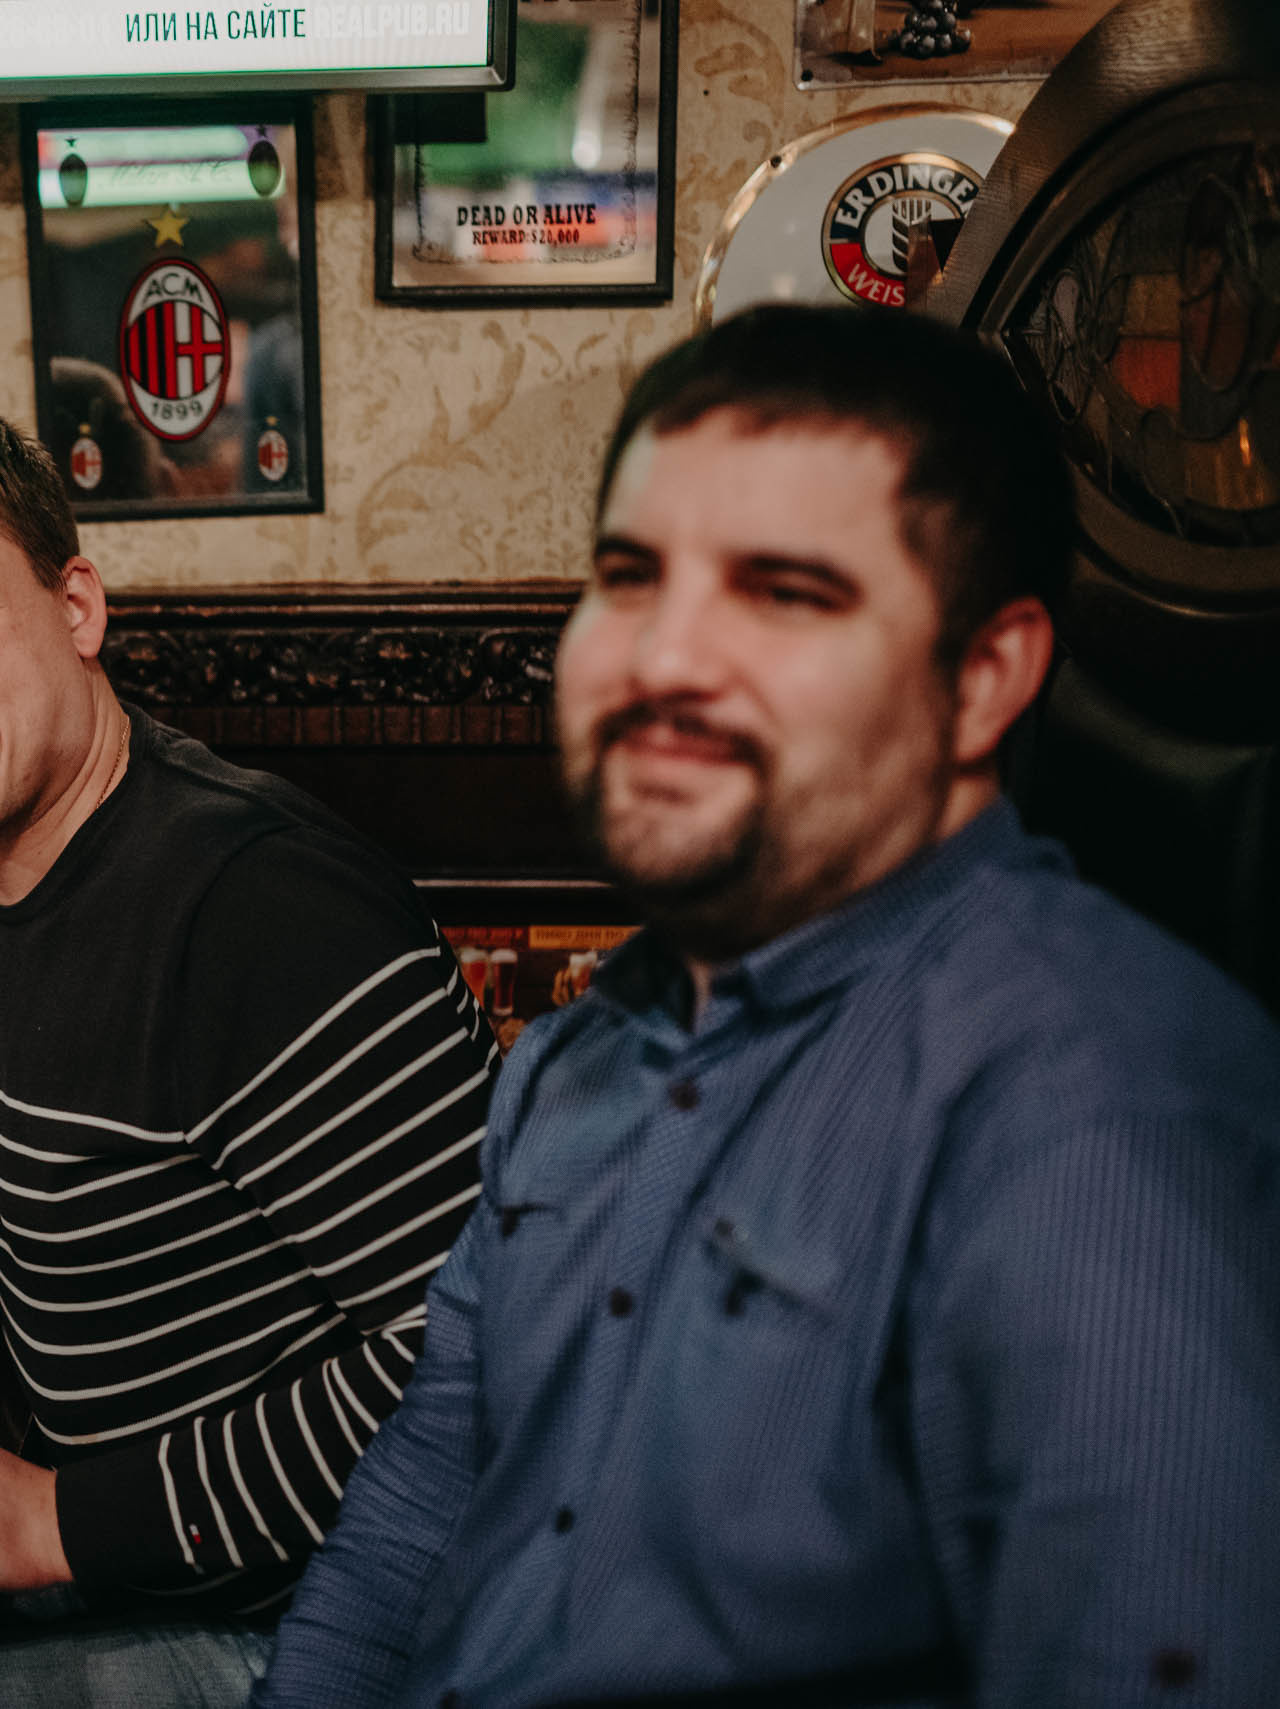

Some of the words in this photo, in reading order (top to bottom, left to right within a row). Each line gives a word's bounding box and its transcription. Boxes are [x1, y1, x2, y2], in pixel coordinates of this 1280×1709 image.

[125, 12, 178, 42] ИЛИ
[185, 11, 218, 41] НА
[226, 2, 307, 40] САЙТЕ
[456, 205, 506, 227] DEAD
[512, 204, 539, 225] OR
[543, 202, 597, 226] ALIVE
[143, 272, 205, 304] ACM
[151, 400, 204, 420] 1899
